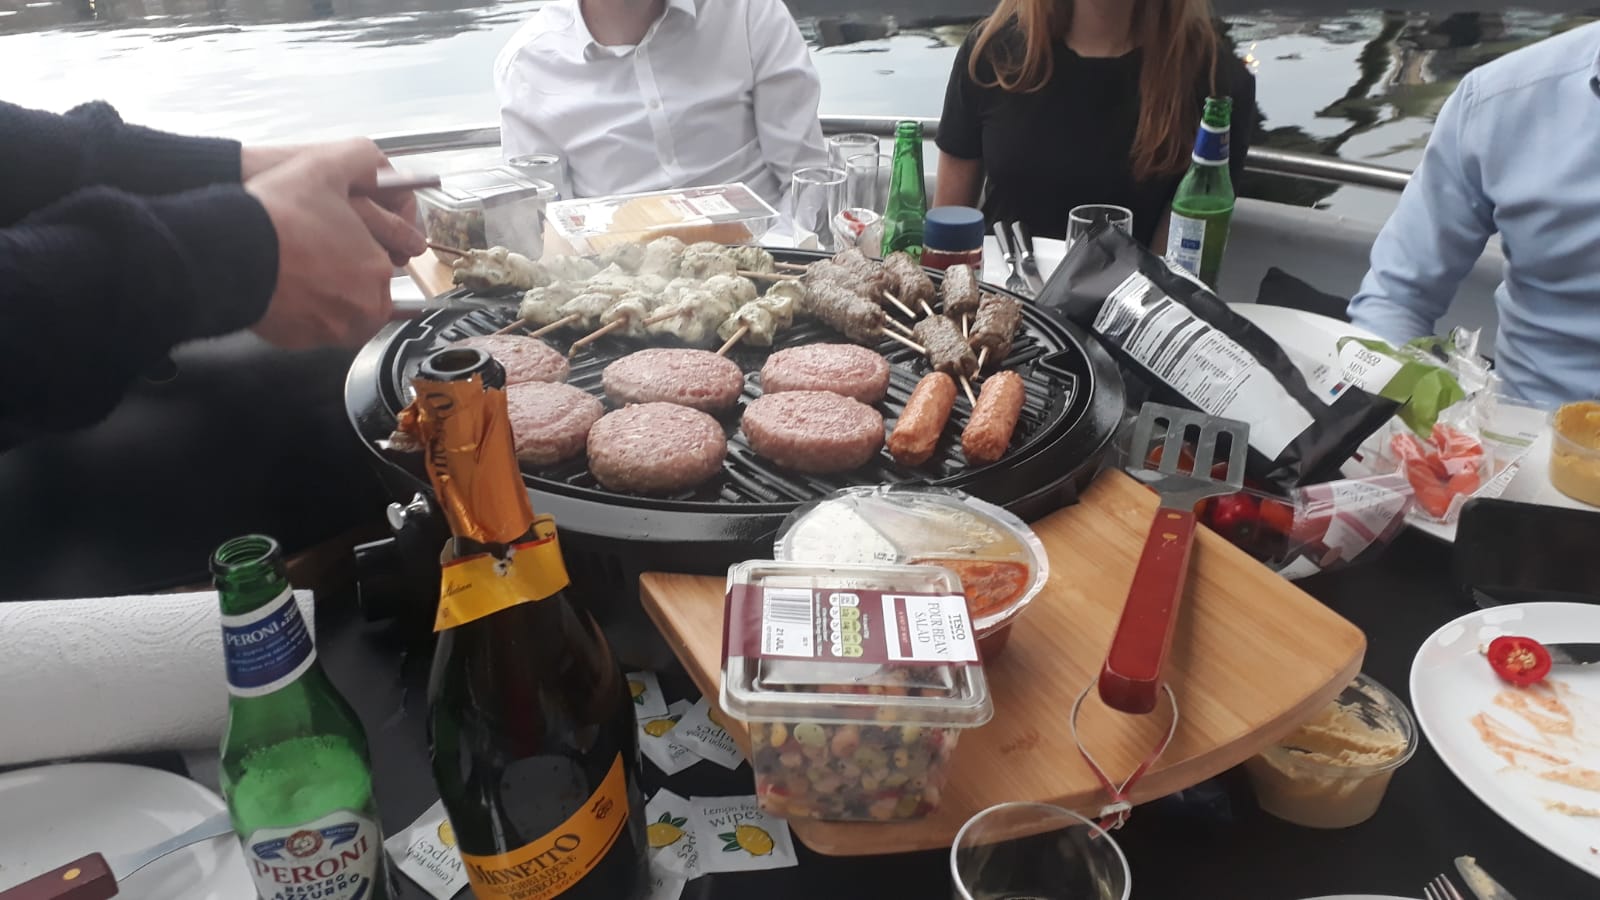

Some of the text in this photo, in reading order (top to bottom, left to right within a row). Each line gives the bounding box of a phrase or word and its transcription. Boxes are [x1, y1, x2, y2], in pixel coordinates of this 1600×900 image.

[225, 620, 280, 647] PERONI
[914, 611, 931, 643] SALAD
[927, 602, 949, 655] FOUR BEAN
[952, 613, 966, 641] TESCO
[703, 806, 738, 817] Lemon
[709, 810, 764, 829] wipes
[254, 834, 369, 885] PERONI
[417, 840, 462, 873] wipes
[284, 873, 345, 894] NASTRO
